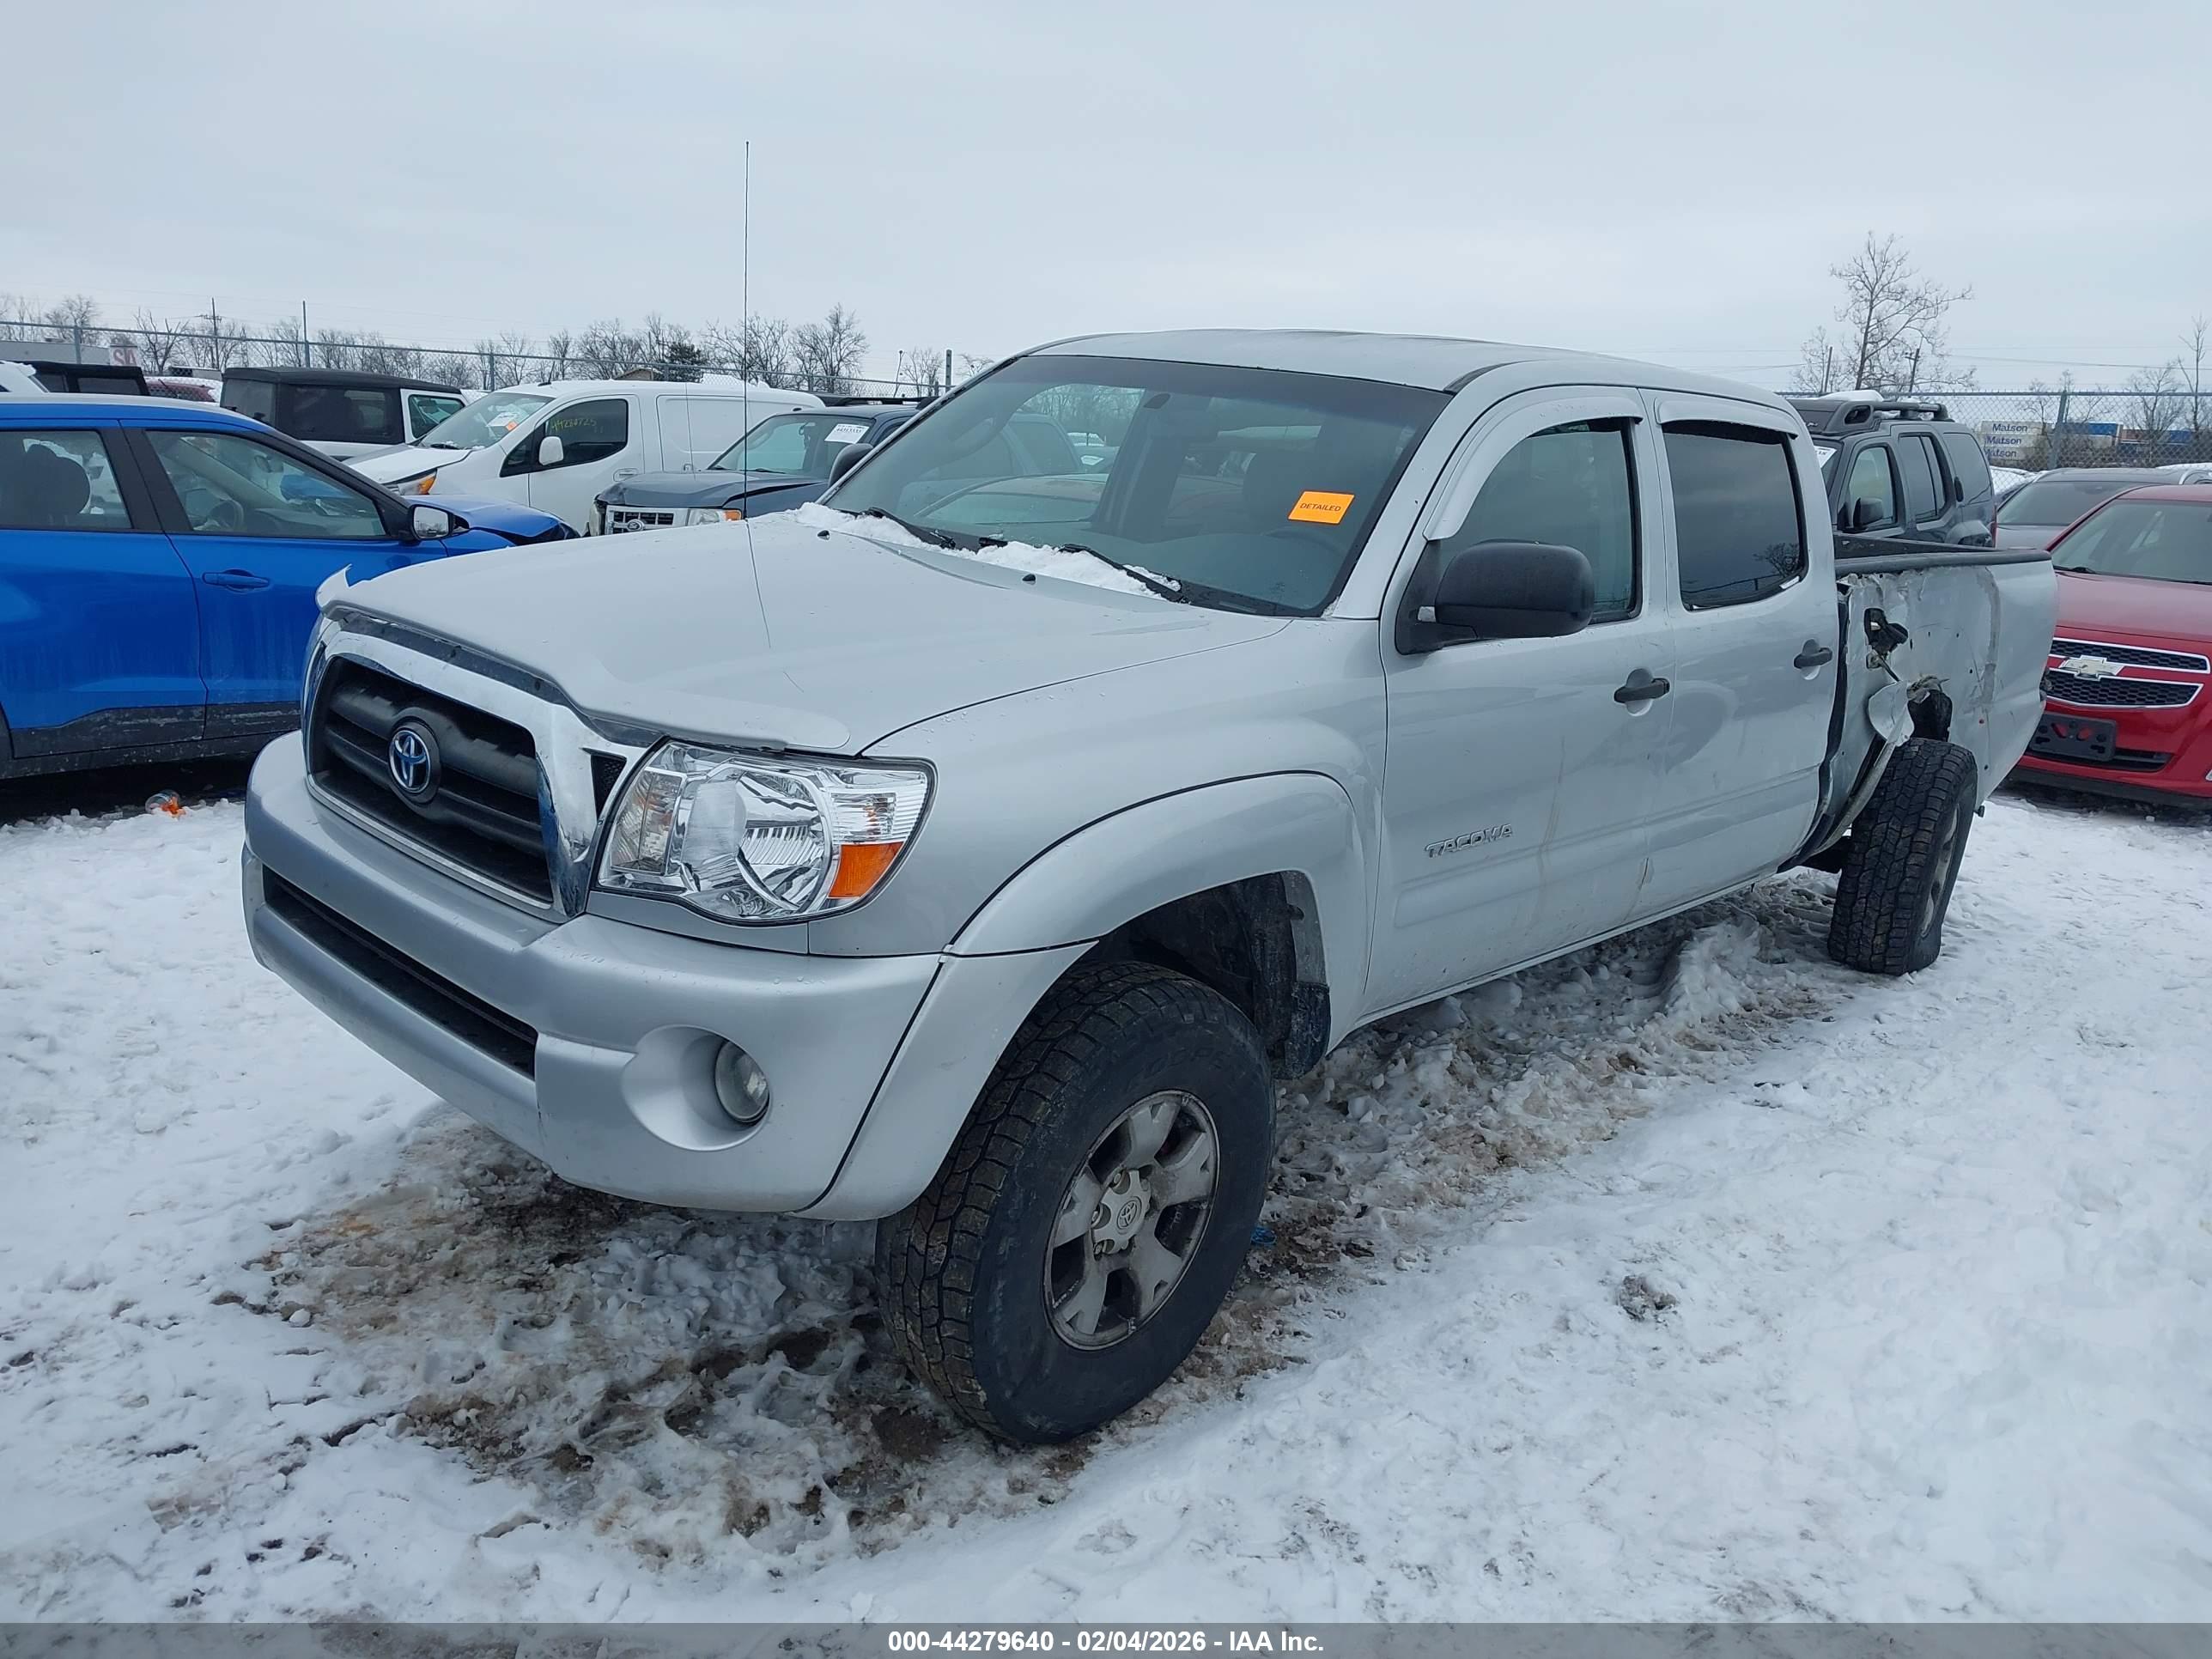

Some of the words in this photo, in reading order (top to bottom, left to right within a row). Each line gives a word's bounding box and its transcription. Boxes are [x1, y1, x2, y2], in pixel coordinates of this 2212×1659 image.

[1992, 423, 2027, 432] Matson
[1986, 435, 2021, 444] Matson
[1299, 502, 1341, 512] DETAILED
[1425, 823, 1512, 858] TACOMA
